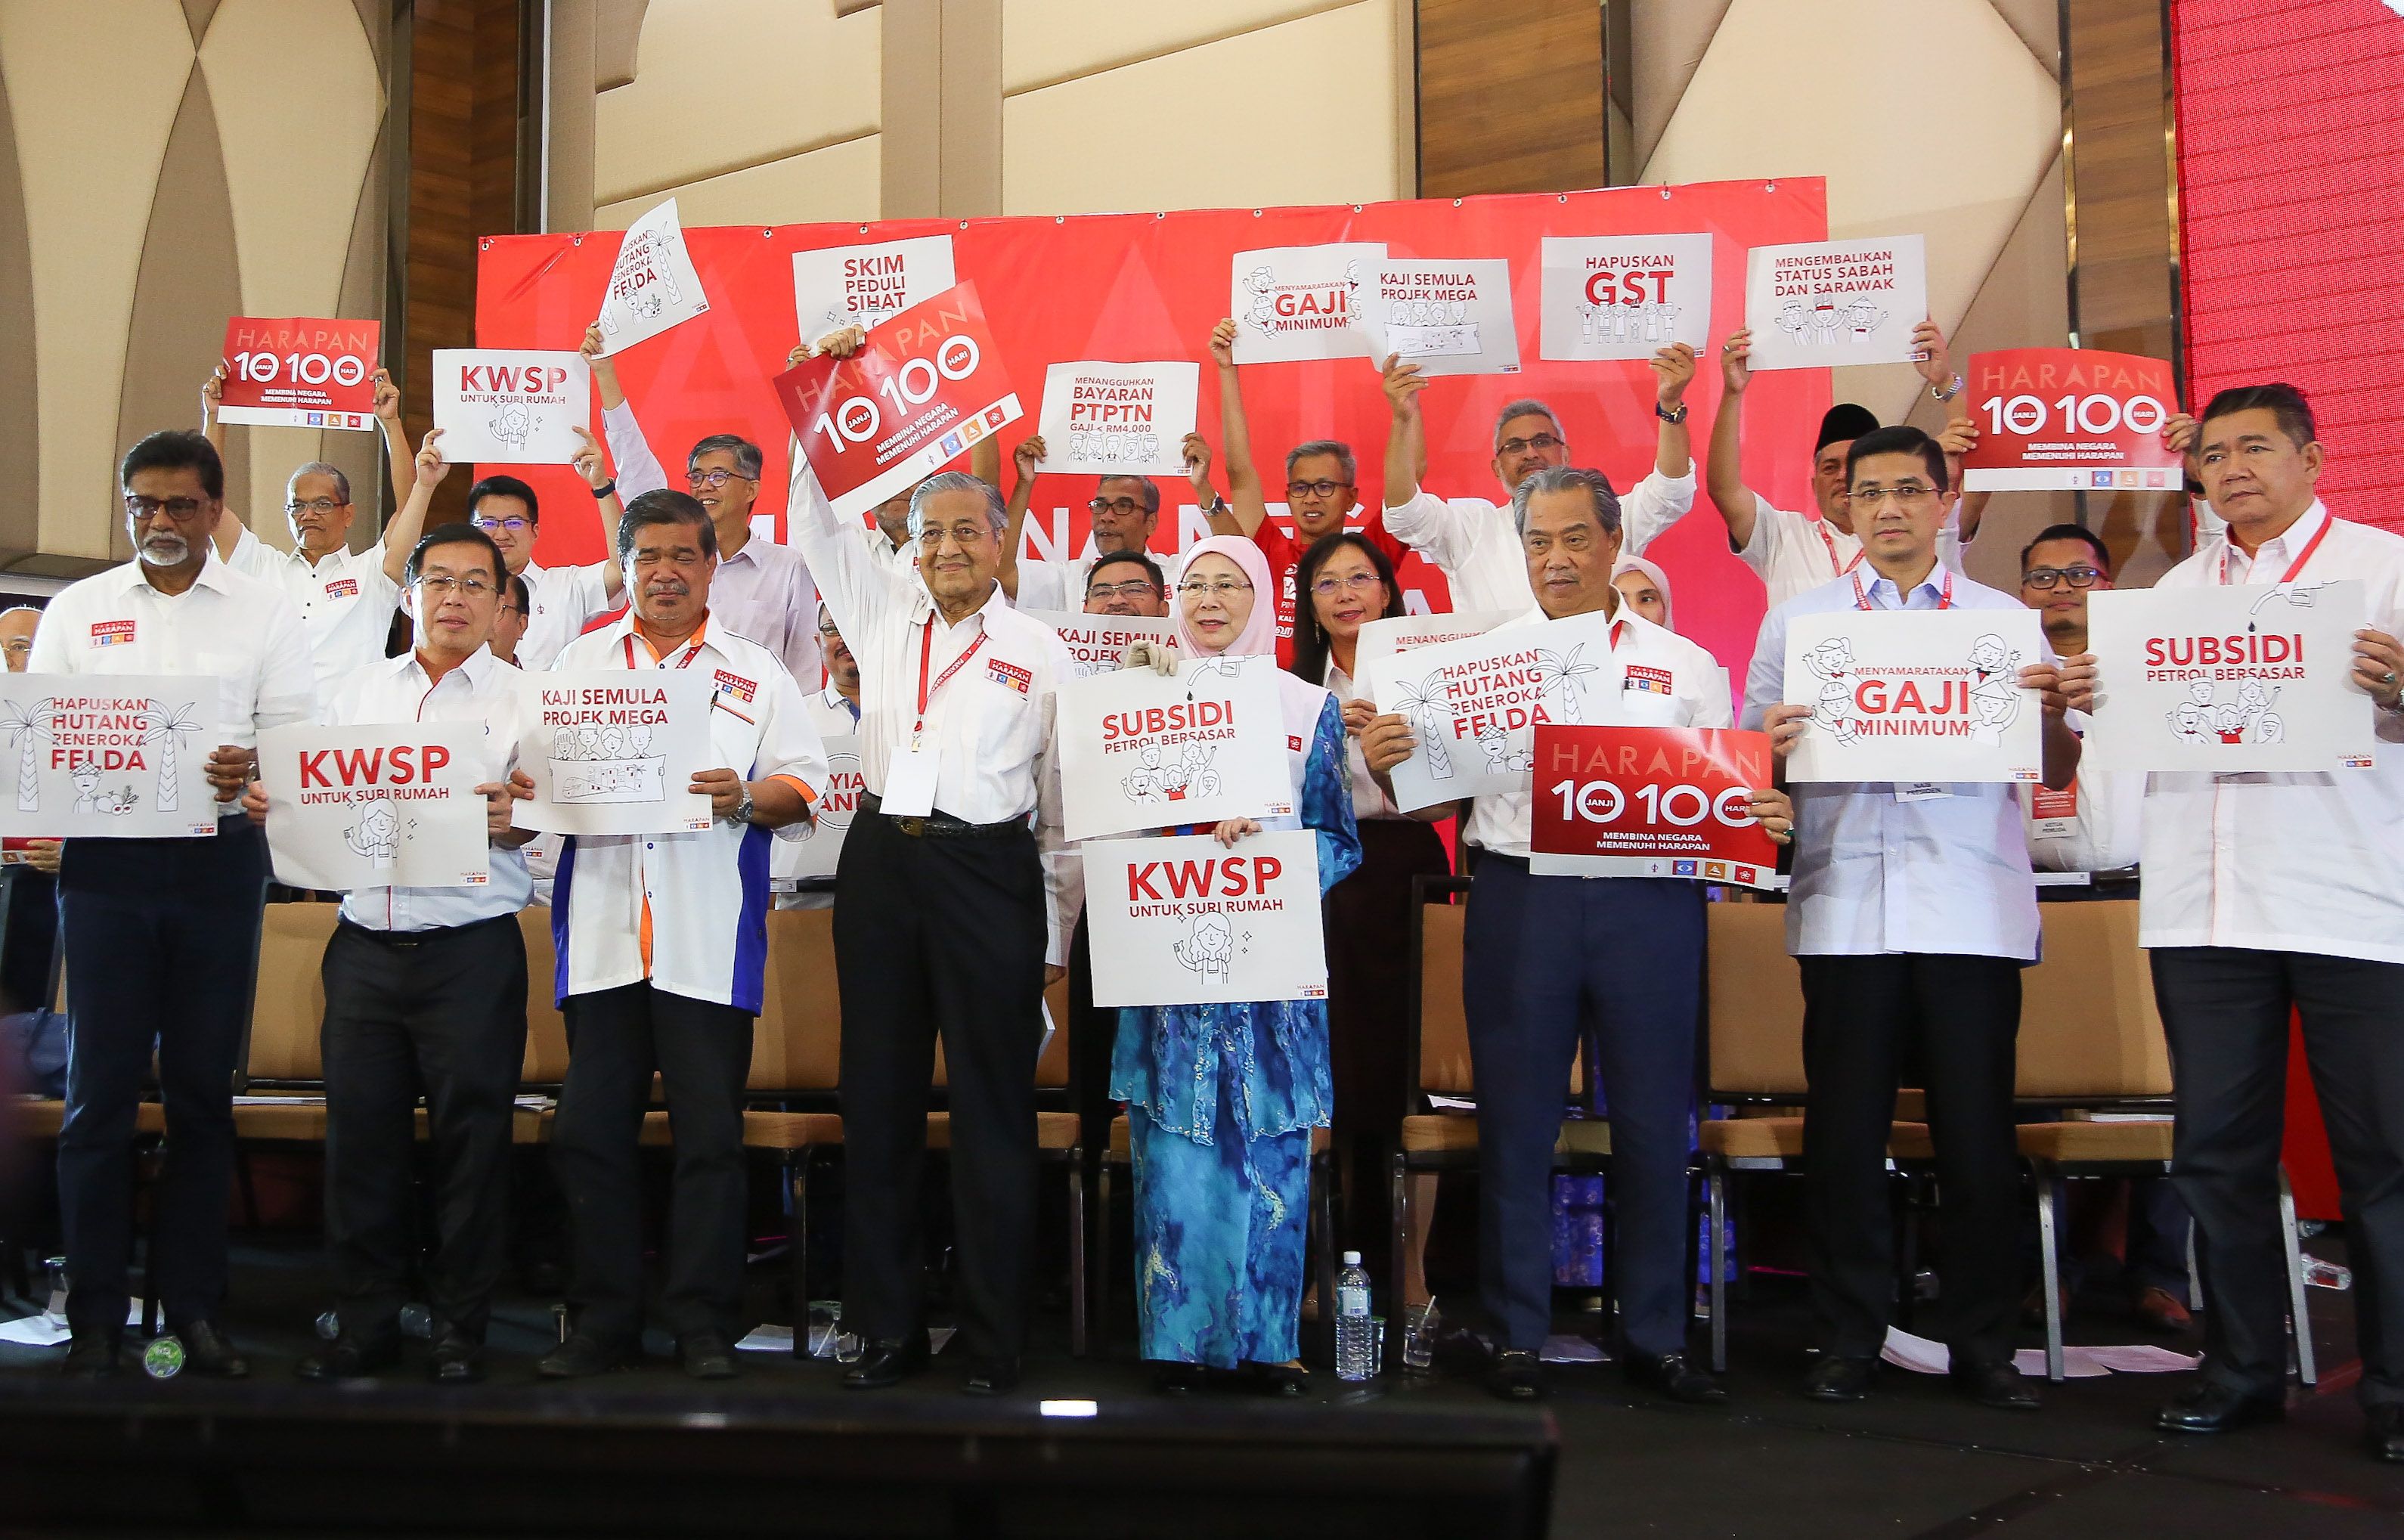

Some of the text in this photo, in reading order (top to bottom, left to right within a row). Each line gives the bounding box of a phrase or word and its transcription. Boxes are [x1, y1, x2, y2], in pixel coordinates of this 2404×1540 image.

[844, 254, 904, 278] SKIM
[1585, 255, 1674, 269] HAPUSKAN
[1775, 250, 1892, 268] MENGEMBALIKAN
[1380, 273, 1476, 287] KAJI SEMULA
[1774, 264, 1894, 283] STATUS SABAH
[845, 276, 906, 293] PEDULI
[1585, 271, 1674, 307] GST
[1774, 277, 1895, 297] DAN SARAWAK
[847, 292, 906, 311] SIHAT
[1275, 290, 1346, 317] GAJI
[1380, 288, 1479, 302] PROJEK MEGA
[1275, 316, 1348, 332] MINIMUM
[237, 328, 368, 352] HARAPAN
[795, 301, 968, 413] HARAPAN
[234, 351, 280, 383] 10
[285, 352, 366, 387] 100
[1981, 363, 2163, 392] HARAPAN
[460, 366, 568, 393] KWSP
[1074, 376, 1154, 386] MENANGGUHKAN
[260, 395, 333, 406] MEMENUHI HARAPAN
[265, 389, 327, 398] MEMBINA NEGARA
[460, 394, 497, 404] UNTUK
[526, 395, 566, 404] RUMAH
[813, 334, 980, 454] 10 JANJI 100 HARI
[1073, 386, 1154, 401] BAYARAN
[1070, 403, 1153, 423] PTPTN
[1981, 394, 2048, 435] 10
[2054, 394, 2167, 435] 100
[875, 402, 950, 454] MEMBINA NEGARA
[875, 407, 959, 466] MEMENUHI HARAPAN
[1070, 423, 1094, 432] GAJI
[1058, 627, 1096, 644] KAJI
[2145, 634, 2303, 667] SUBSIDI
[991, 663, 1030, 682] HARAPAN
[1443, 649, 1538, 680] HAPUSKAN
[1854, 667, 1969, 676] MENYAMARATAKAN
[2215, 666, 2306, 681] BERSASAR
[717, 674, 754, 693] HARAPAN
[1446, 669, 1543, 700] HUTANG
[53, 697, 148, 711] HAPUSKAN
[542, 688, 668, 705] KAJI SEMULA
[1854, 680, 1969, 714] GAJI
[52, 714, 148, 730] HUTANG
[543, 709, 669, 726] PROJEK MEGA
[1102, 700, 1234, 740] SUBSIDI
[1453, 703, 1552, 740] FELDA
[1161, 728, 1236, 746] BERSASAR
[1854, 720, 1969, 736] MINIMUM
[51, 749, 147, 771] FELDA
[299, 745, 451, 789] KWSP
[1552, 742, 1762, 782] HARAPAN
[301, 790, 352, 804] UNTUK
[394, 787, 450, 801] RUMAH
[1551, 779, 1625, 824] 10
[1586, 798, 1614, 807] JANJI
[1596, 841, 1711, 851] MEMENUHI HARAPAN
[1603, 832, 1702, 842] MEMBINA NEGARA
[1127, 857, 1282, 901] KWSP
[1129, 903, 1182, 918] UNTUK
[1226, 899, 1284, 913] RUMAH
